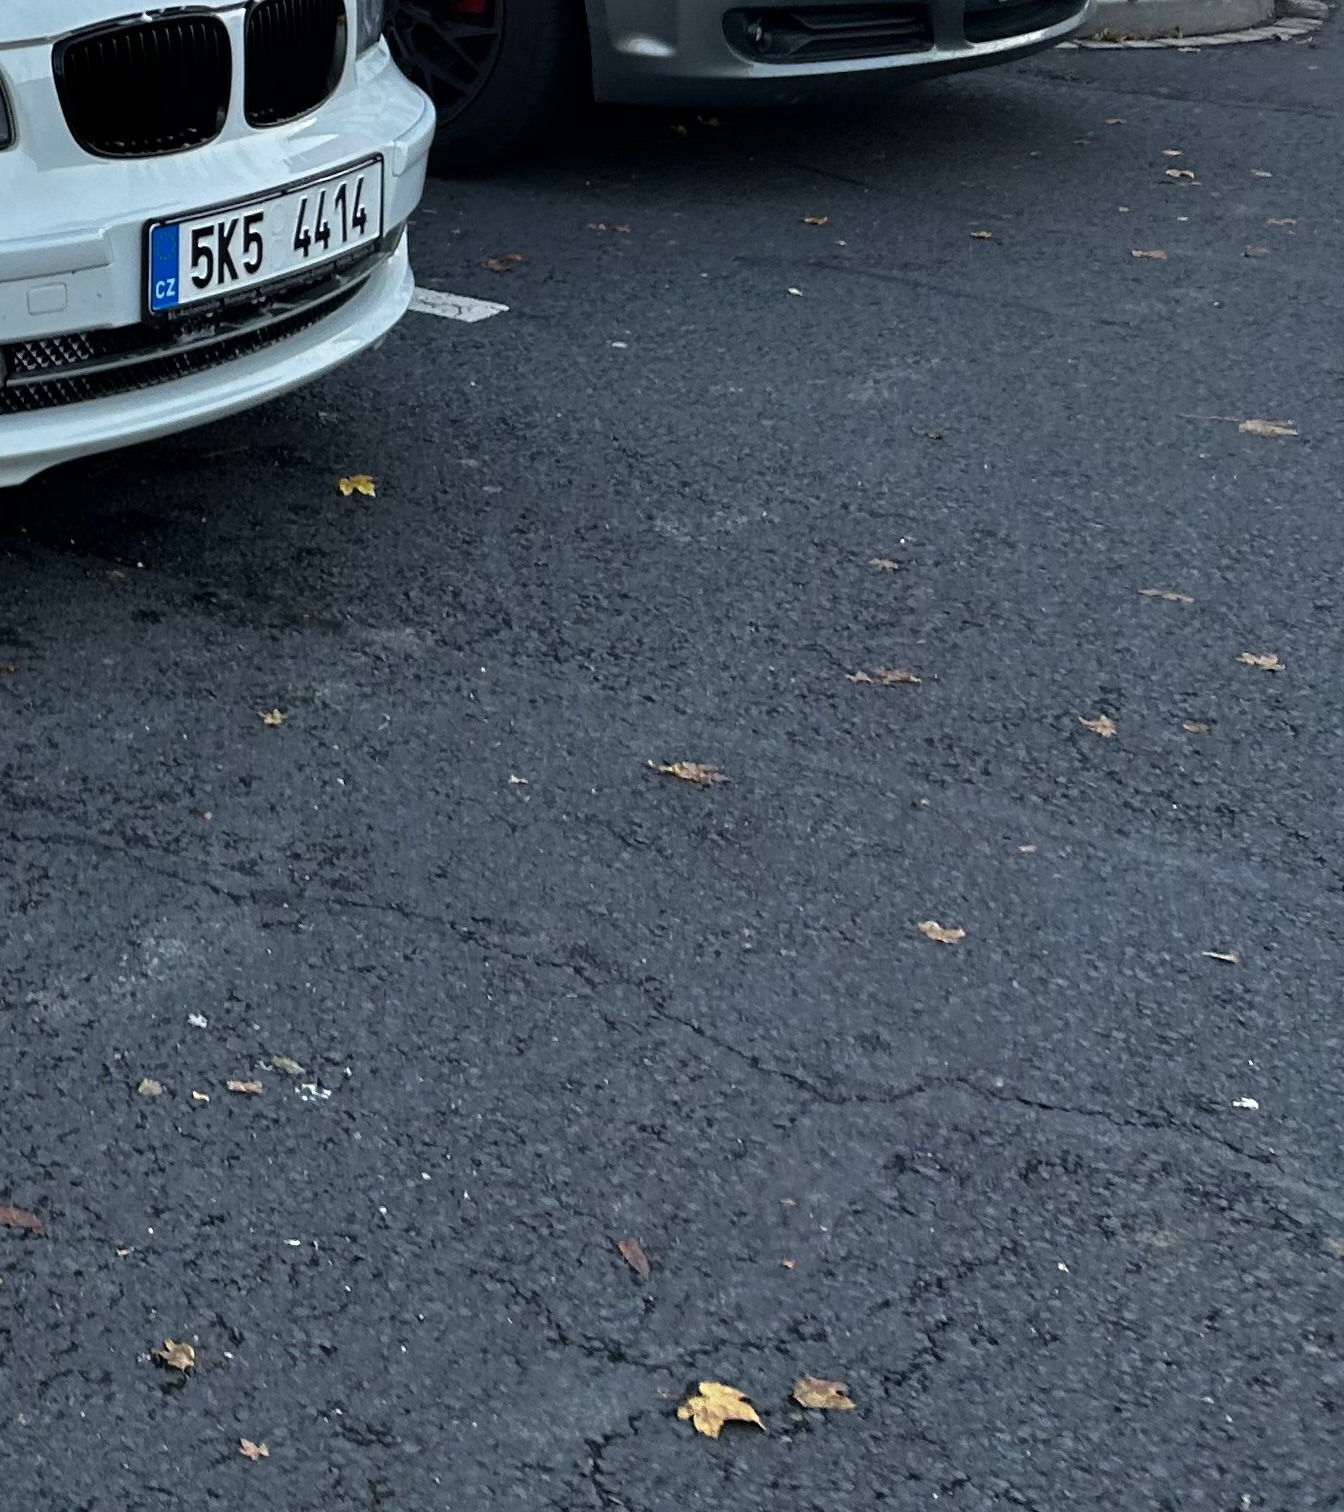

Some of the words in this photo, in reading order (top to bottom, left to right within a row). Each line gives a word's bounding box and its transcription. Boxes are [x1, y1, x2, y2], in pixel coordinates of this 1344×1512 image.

[191, 211, 264, 289] 5K5
[293, 175, 367, 258] 4414
[155, 277, 176, 300] CZ
